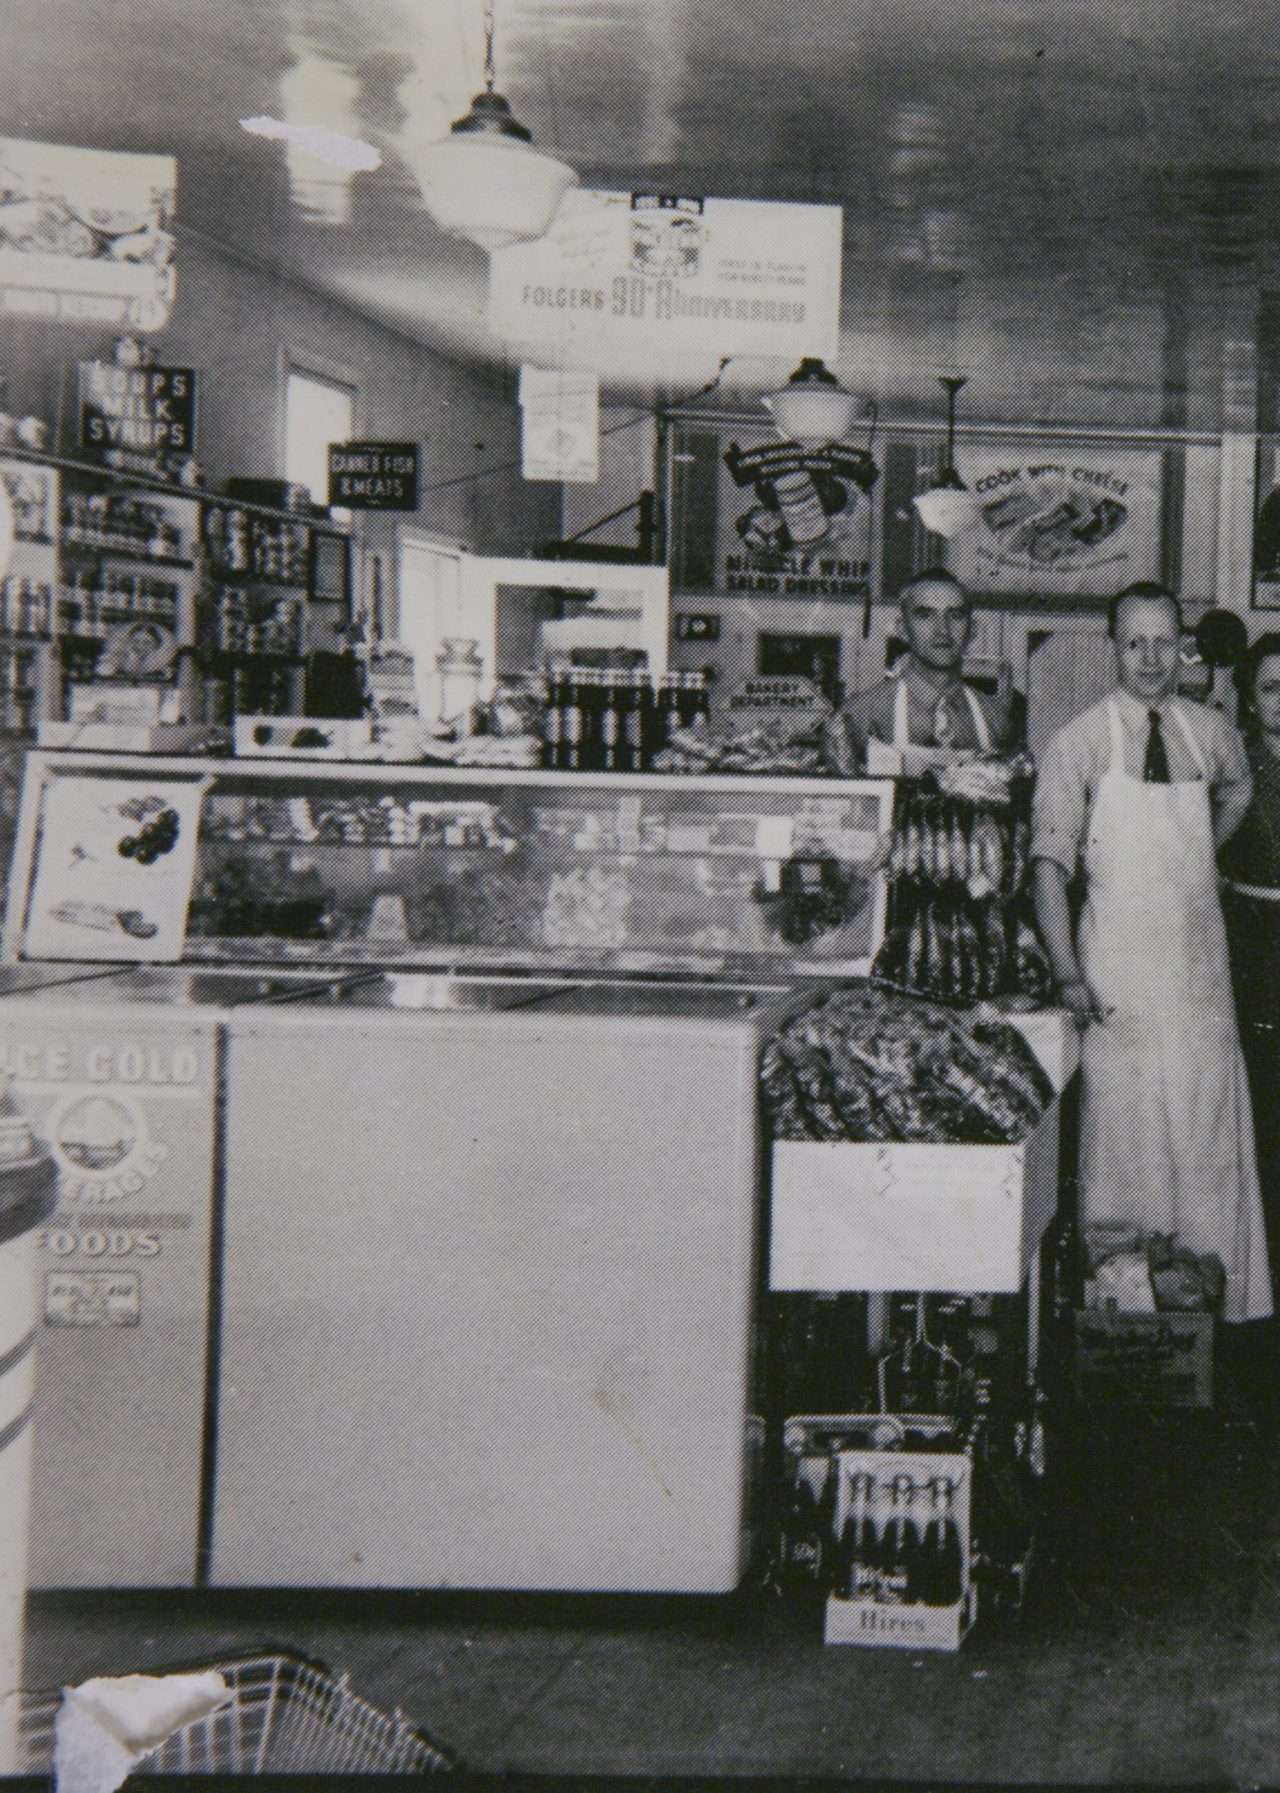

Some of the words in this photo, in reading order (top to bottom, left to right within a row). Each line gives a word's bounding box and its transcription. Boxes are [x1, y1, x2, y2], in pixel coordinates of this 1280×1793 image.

[91, 369, 187, 398] SOUPS
[101, 396, 173, 420] MILK
[89, 417, 185, 447] SYRUPS
[975, 468, 1023, 494] COOK
[1071, 467, 1128, 497] CHEESE
[819, 560, 871, 577] WHIP
[726, 575, 780, 592] SALAD
[785, 578, 871, 596] DRESSING
[745, 681, 799, 694] BAKERY
[730, 695, 814, 709] DEPARTMENT
[87, 1043, 198, 1083] COLD
[859, 1608, 927, 1632] Hires
